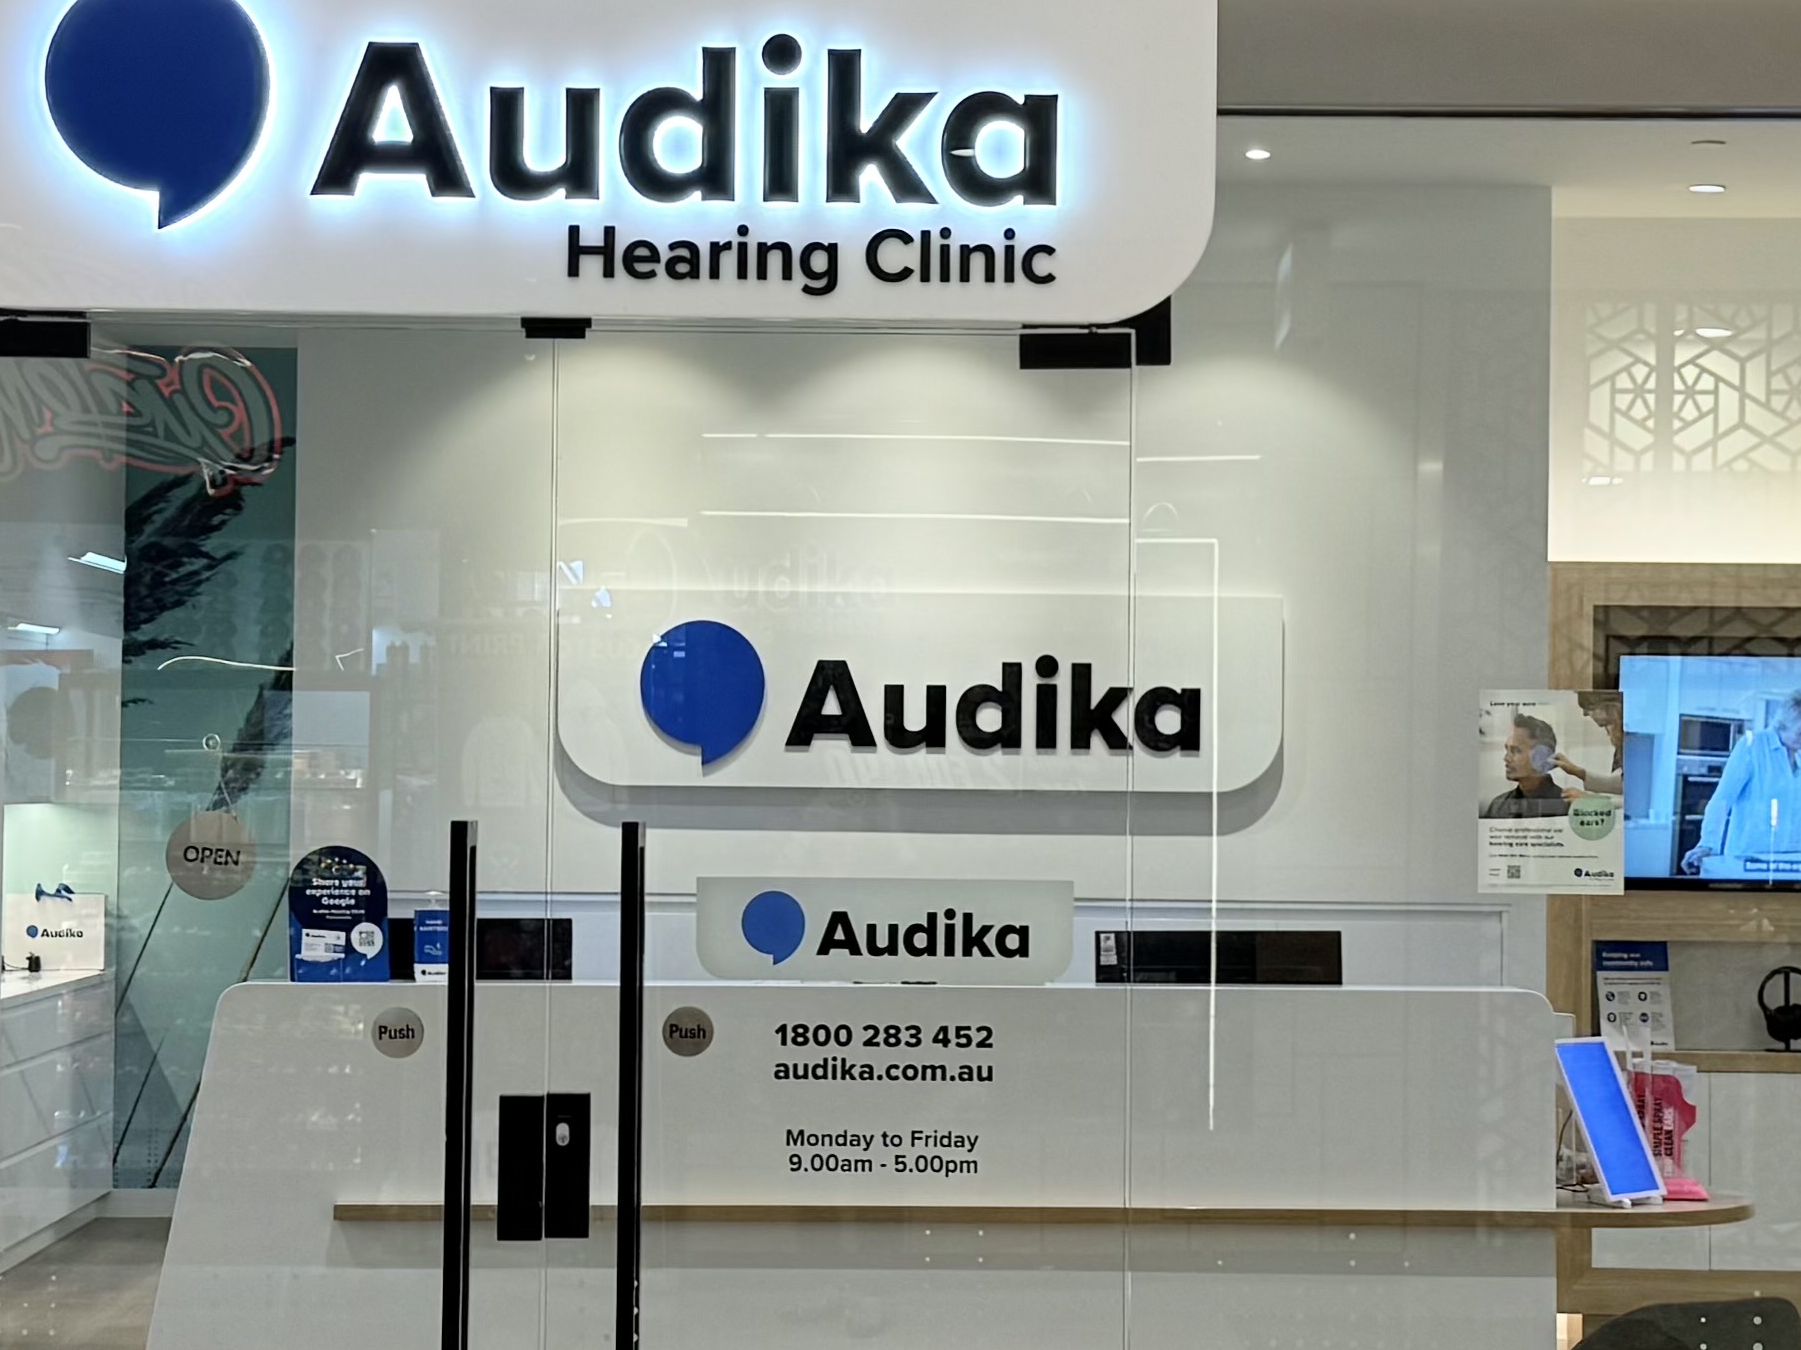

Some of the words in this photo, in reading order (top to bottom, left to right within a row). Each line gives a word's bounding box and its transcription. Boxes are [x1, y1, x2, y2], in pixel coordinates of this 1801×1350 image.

[310, 33, 1059, 207] Audika
[565, 225, 839, 295] Hearing
[864, 226, 1057, 285] Clinic
[784, 655, 1202, 753] Audika
[183, 844, 241, 868] OPEN
[321, 896, 356, 907] Google
[41, 928, 84, 939] Audika
[816, 908, 1030, 959] Audika
[378, 1024, 416, 1041] Push
[668, 1024, 707, 1041] Push
[774, 1025, 853, 1048] 1800
[861, 1025, 922, 1048] 283
[931, 1026, 994, 1049] 452
[773, 1059, 994, 1083] audika.com.au
[786, 1129, 874, 1153] Monday
[880, 1131, 903, 1150] to
[911, 1130, 979, 1154] Friday
[1663, 1129, 1674, 1157] CLEAN
[788, 1155, 873, 1174] 9.00am
[894, 1155, 979, 1179] 5.00pm
